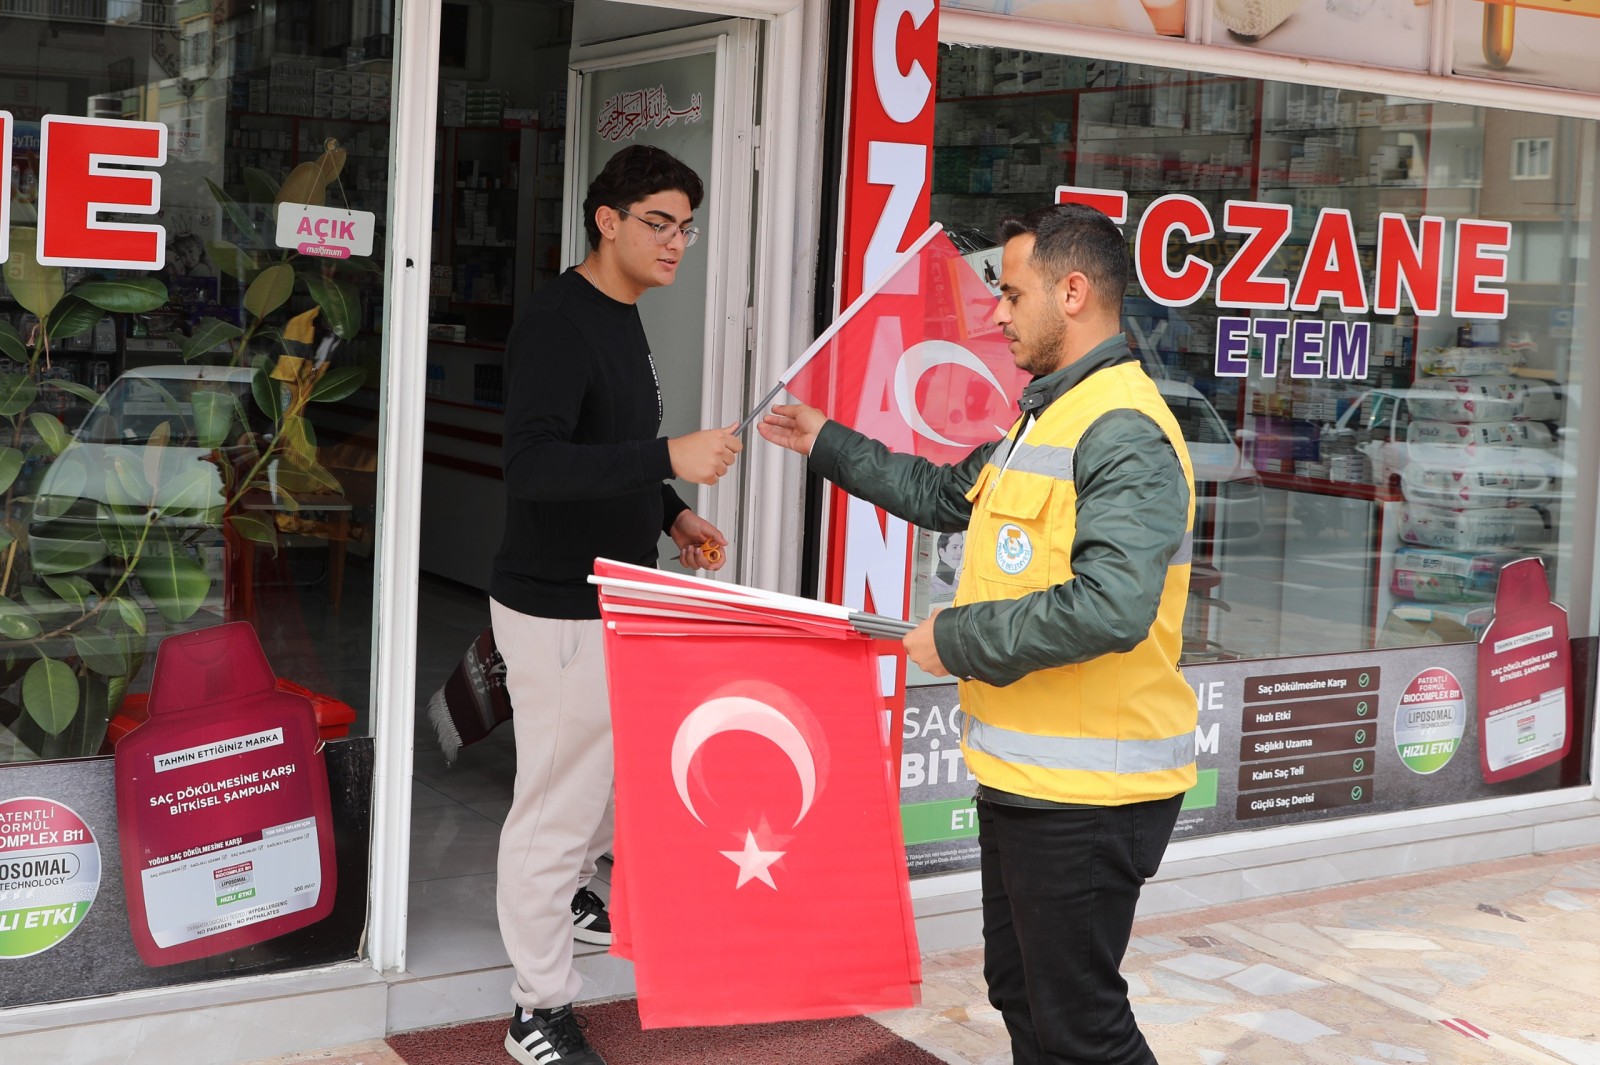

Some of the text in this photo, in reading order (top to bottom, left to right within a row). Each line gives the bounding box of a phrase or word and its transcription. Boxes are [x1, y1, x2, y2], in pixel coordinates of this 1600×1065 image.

[0, 110, 168, 271] E
[296, 216, 356, 244] AÇIK
[306, 246, 342, 257] maximum
[1214, 316, 1370, 380] ETEM
[1258, 678, 1347, 695] Saç Dökülmesine Karşı
[1403, 690, 1448, 702] BIOCOMPLEX
[1256, 710, 1292, 722] Hızlı Etki
[1408, 708, 1452, 724] LIPOSOMAL
[158, 733, 278, 767] TAHMİN ETTİĞİNİZ MARKA
[1254, 739, 1312, 754] Sağlıklı Uzama
[1402, 738, 1455, 758] HIZLI ETKİ
[900, 738, 976, 788] BİT
[1252, 766, 1305, 780] Kalın Saç Teli
[150, 764, 296, 807] SAÇ DÖKÜLMESİNE KARŞI
[170, 780, 280, 816] BİTKİSEL ŞAMPUAN
[1250, 793, 1315, 811] Güçlü Saç Derisi
[63, 829, 84, 842] B11
[148, 836, 243, 867] YOĞUN SAÇ DÖKÜLMESİNE KARŞI
[221, 876, 246, 887] LIPOSOMAL
[220, 889, 252, 904] HIZLI ETKİ
[24, 903, 77, 929] ETKİ
[206, 922, 232, 932] PARABEN
[246, 908, 280, 922] PHTHALATES
